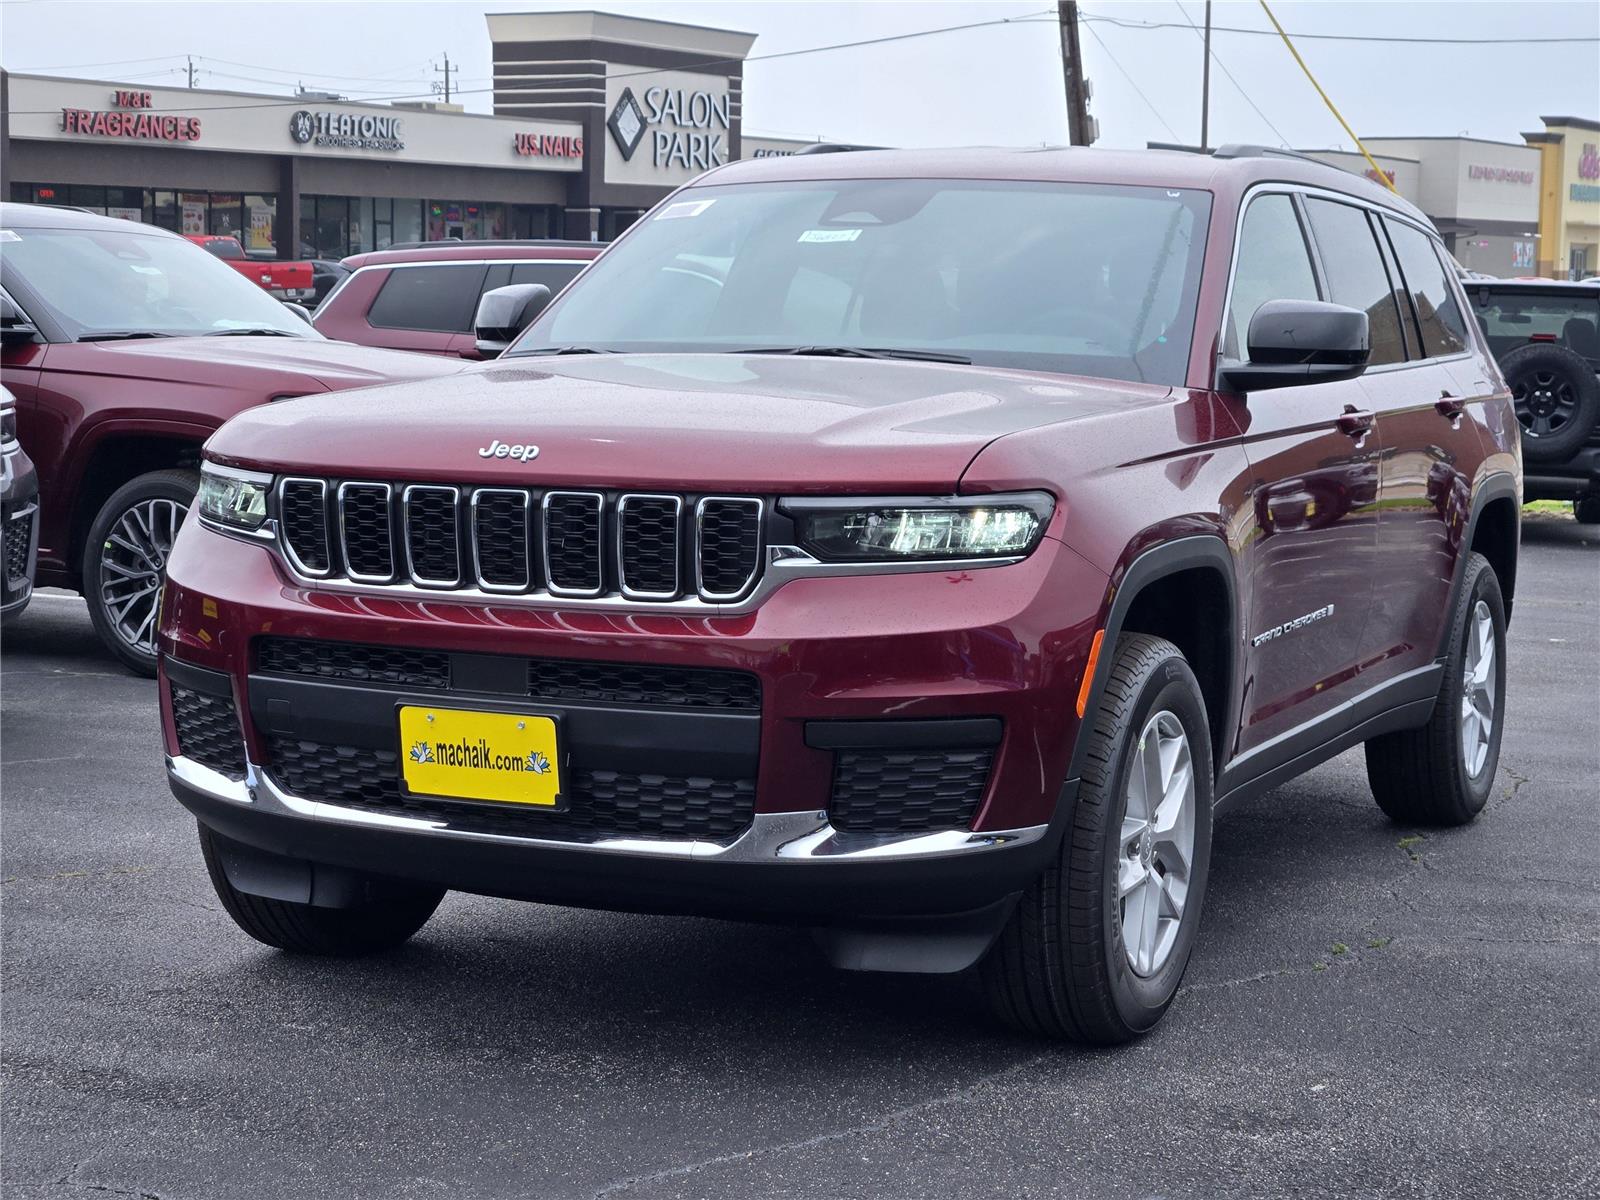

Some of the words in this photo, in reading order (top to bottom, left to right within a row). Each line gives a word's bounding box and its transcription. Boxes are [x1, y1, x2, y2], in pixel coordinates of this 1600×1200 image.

[63, 108, 201, 141] FRAGRANCES
[645, 87, 730, 129] SALON
[316, 112, 405, 140] TEATONIC
[540, 135, 584, 158] NAILS
[653, 131, 720, 169] PARK
[479, 440, 540, 463] Jeep
[1252, 625, 1282, 647] GRAND
[1283, 607, 1327, 633] CHEROKEE
[436, 737, 524, 772] machaik.com
